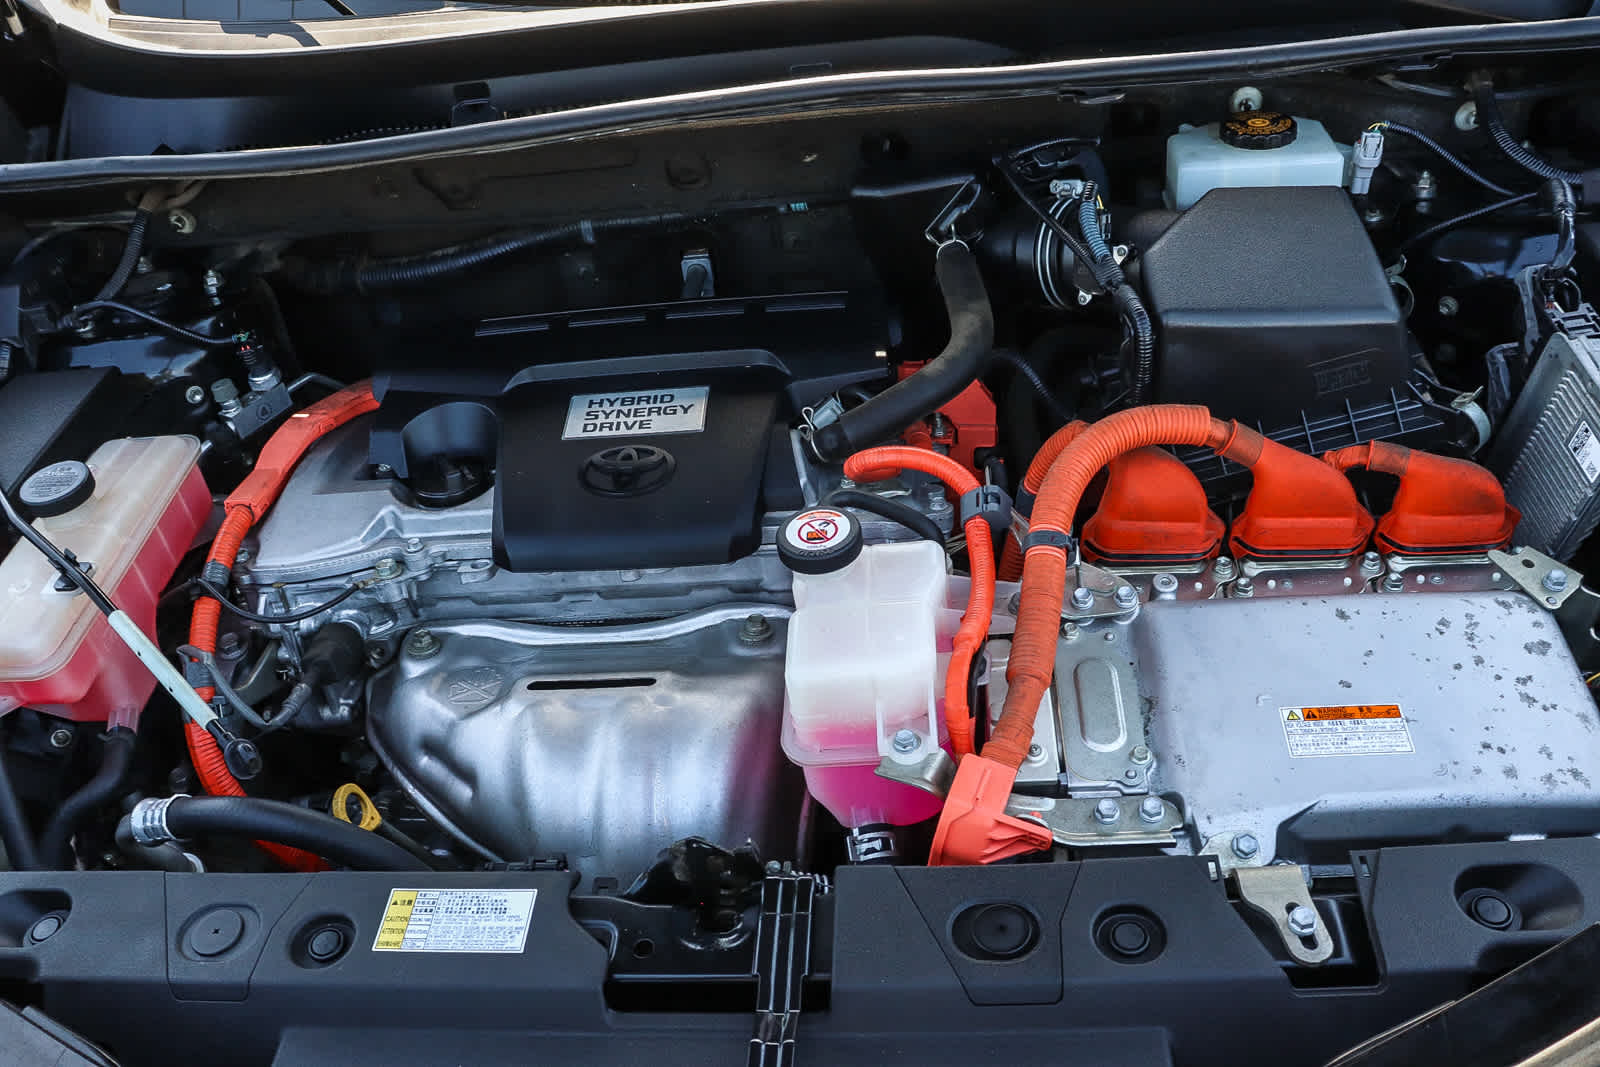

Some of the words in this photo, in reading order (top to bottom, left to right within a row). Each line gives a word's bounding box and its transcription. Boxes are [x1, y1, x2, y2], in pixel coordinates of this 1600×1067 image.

[587, 393, 675, 409] HYBRID
[584, 403, 695, 421] SYNERGY
[582, 418, 653, 433] DRIVE
